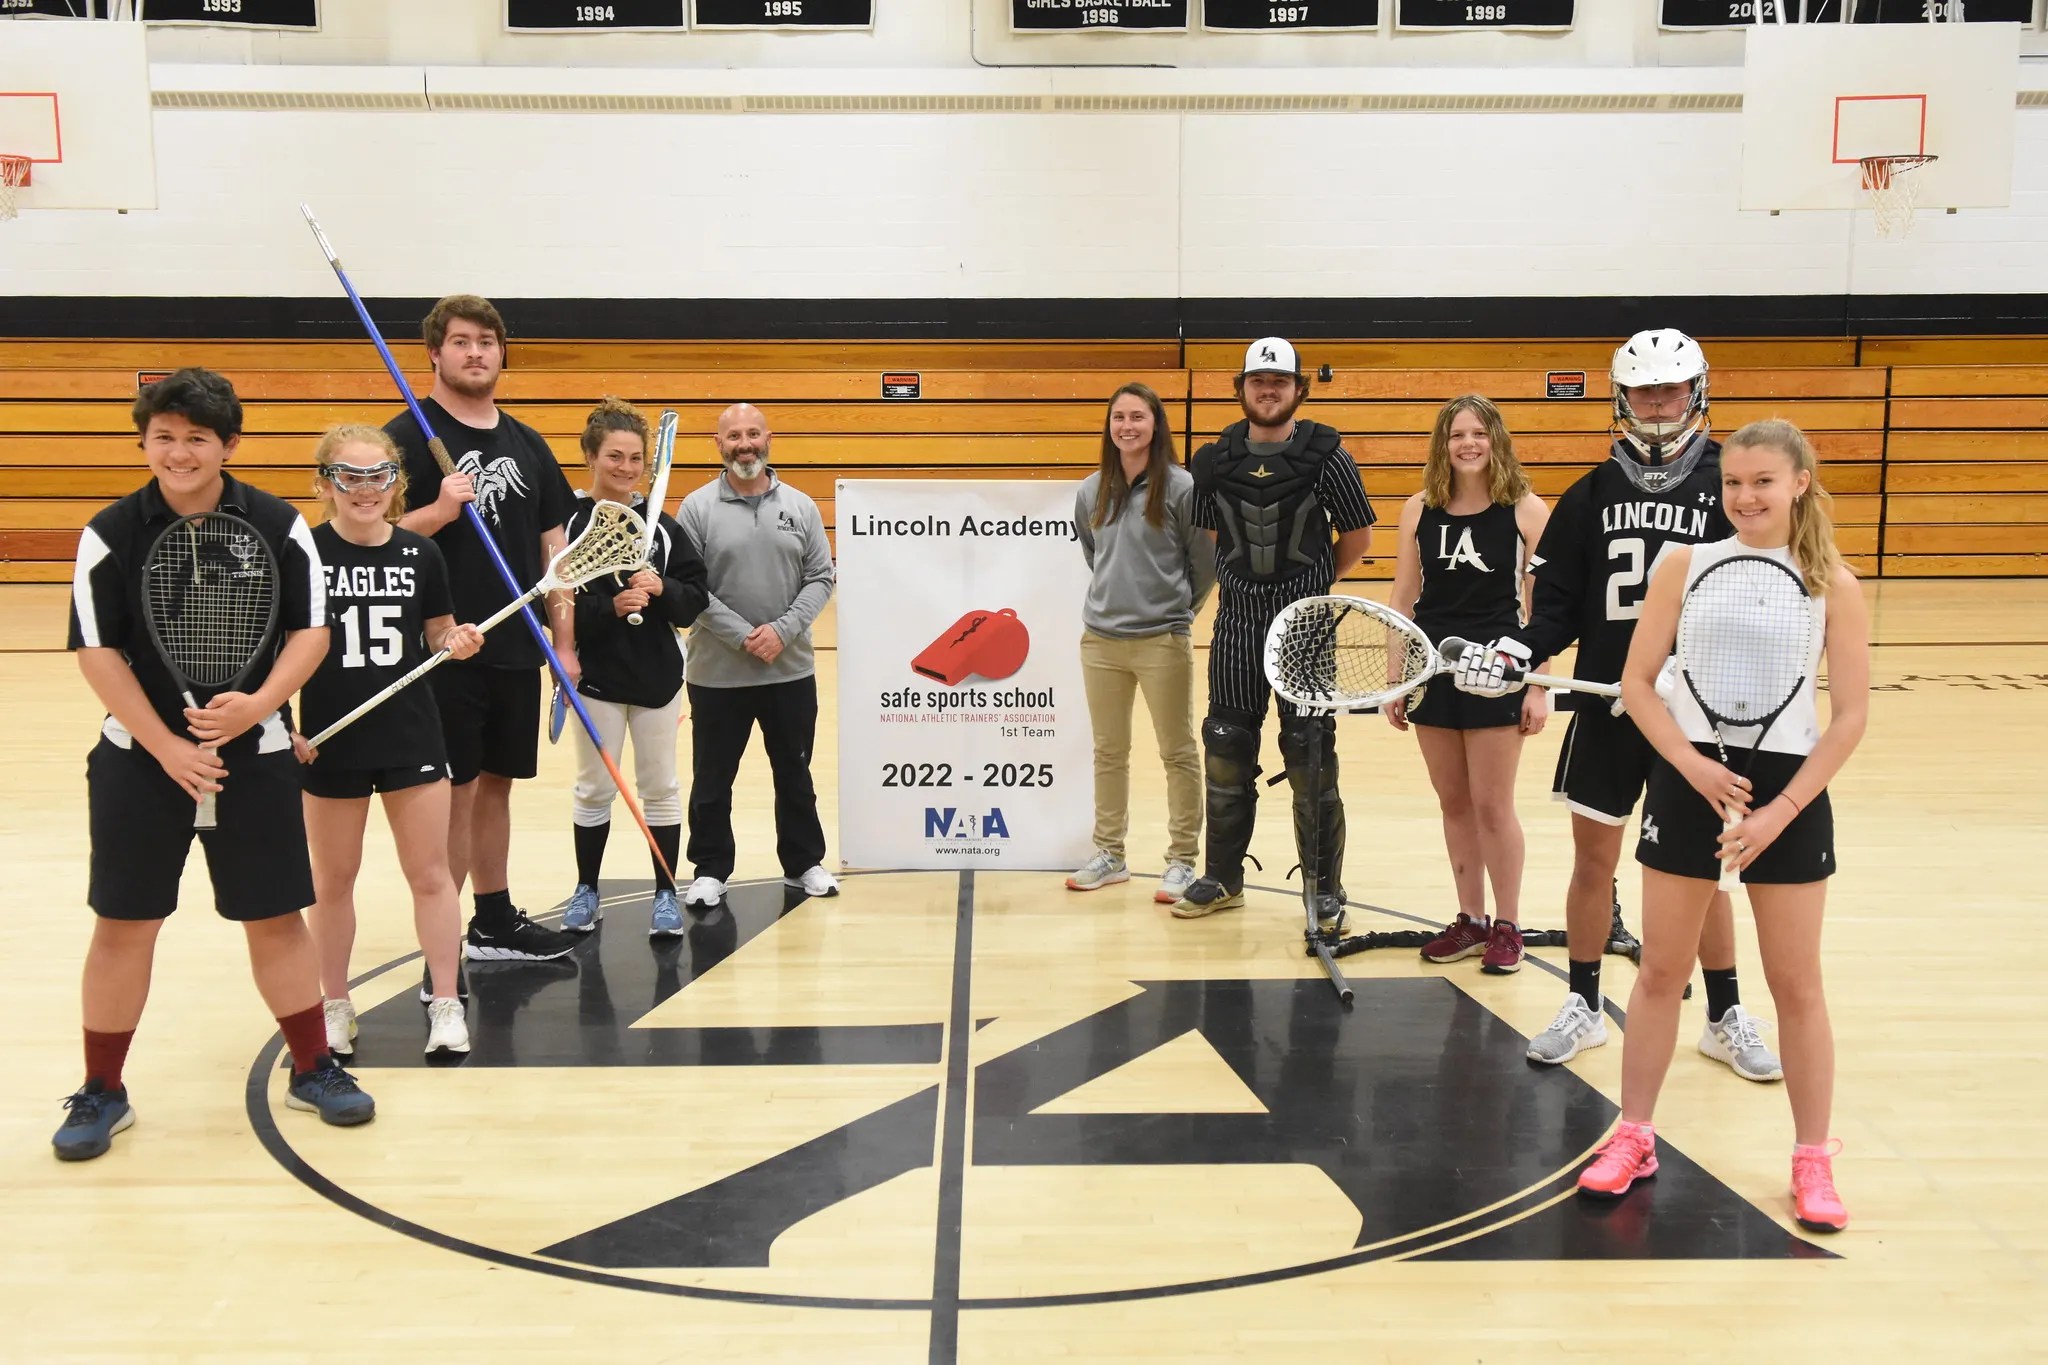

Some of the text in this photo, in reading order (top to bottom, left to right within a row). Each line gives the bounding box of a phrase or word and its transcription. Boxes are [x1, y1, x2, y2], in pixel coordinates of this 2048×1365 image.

[203, 0, 241, 12] 1993
[576, 6, 615, 21] 1994
[764, 1, 802, 16] 1995
[1466, 5, 1506, 20] 1998
[1082, 9, 1119, 24] 1996
[1269, 7, 1309, 22] 1997
[1260, 346, 1277, 362] LA
[1643, 471, 1668, 480] STX
[779, 511, 795, 527] LA
[1602, 501, 1708, 538] LINCOLN
[852, 515, 1079, 542] Lincoln Academy
[1437, 524, 1495, 573] LA
[322, 565, 415, 597] EAGLES
[1606, 537, 1692, 621] 2
[340, 605, 403, 668] 15
[880, 687, 1055, 713] safe sports school
[880, 713, 918, 723] NATIONAL
[921, 713, 957, 723] ATHLETIC
[1004, 713, 1056, 723] ASSOCIATION
[1000, 726, 1055, 737] 1st Team
[882, 763, 952, 788] 2022
[983, 763, 1054, 788] 2025
[925, 807, 1010, 838] NATA
[1641, 813, 1660, 845] LA
[935, 847, 1000, 857] www.nata.org
